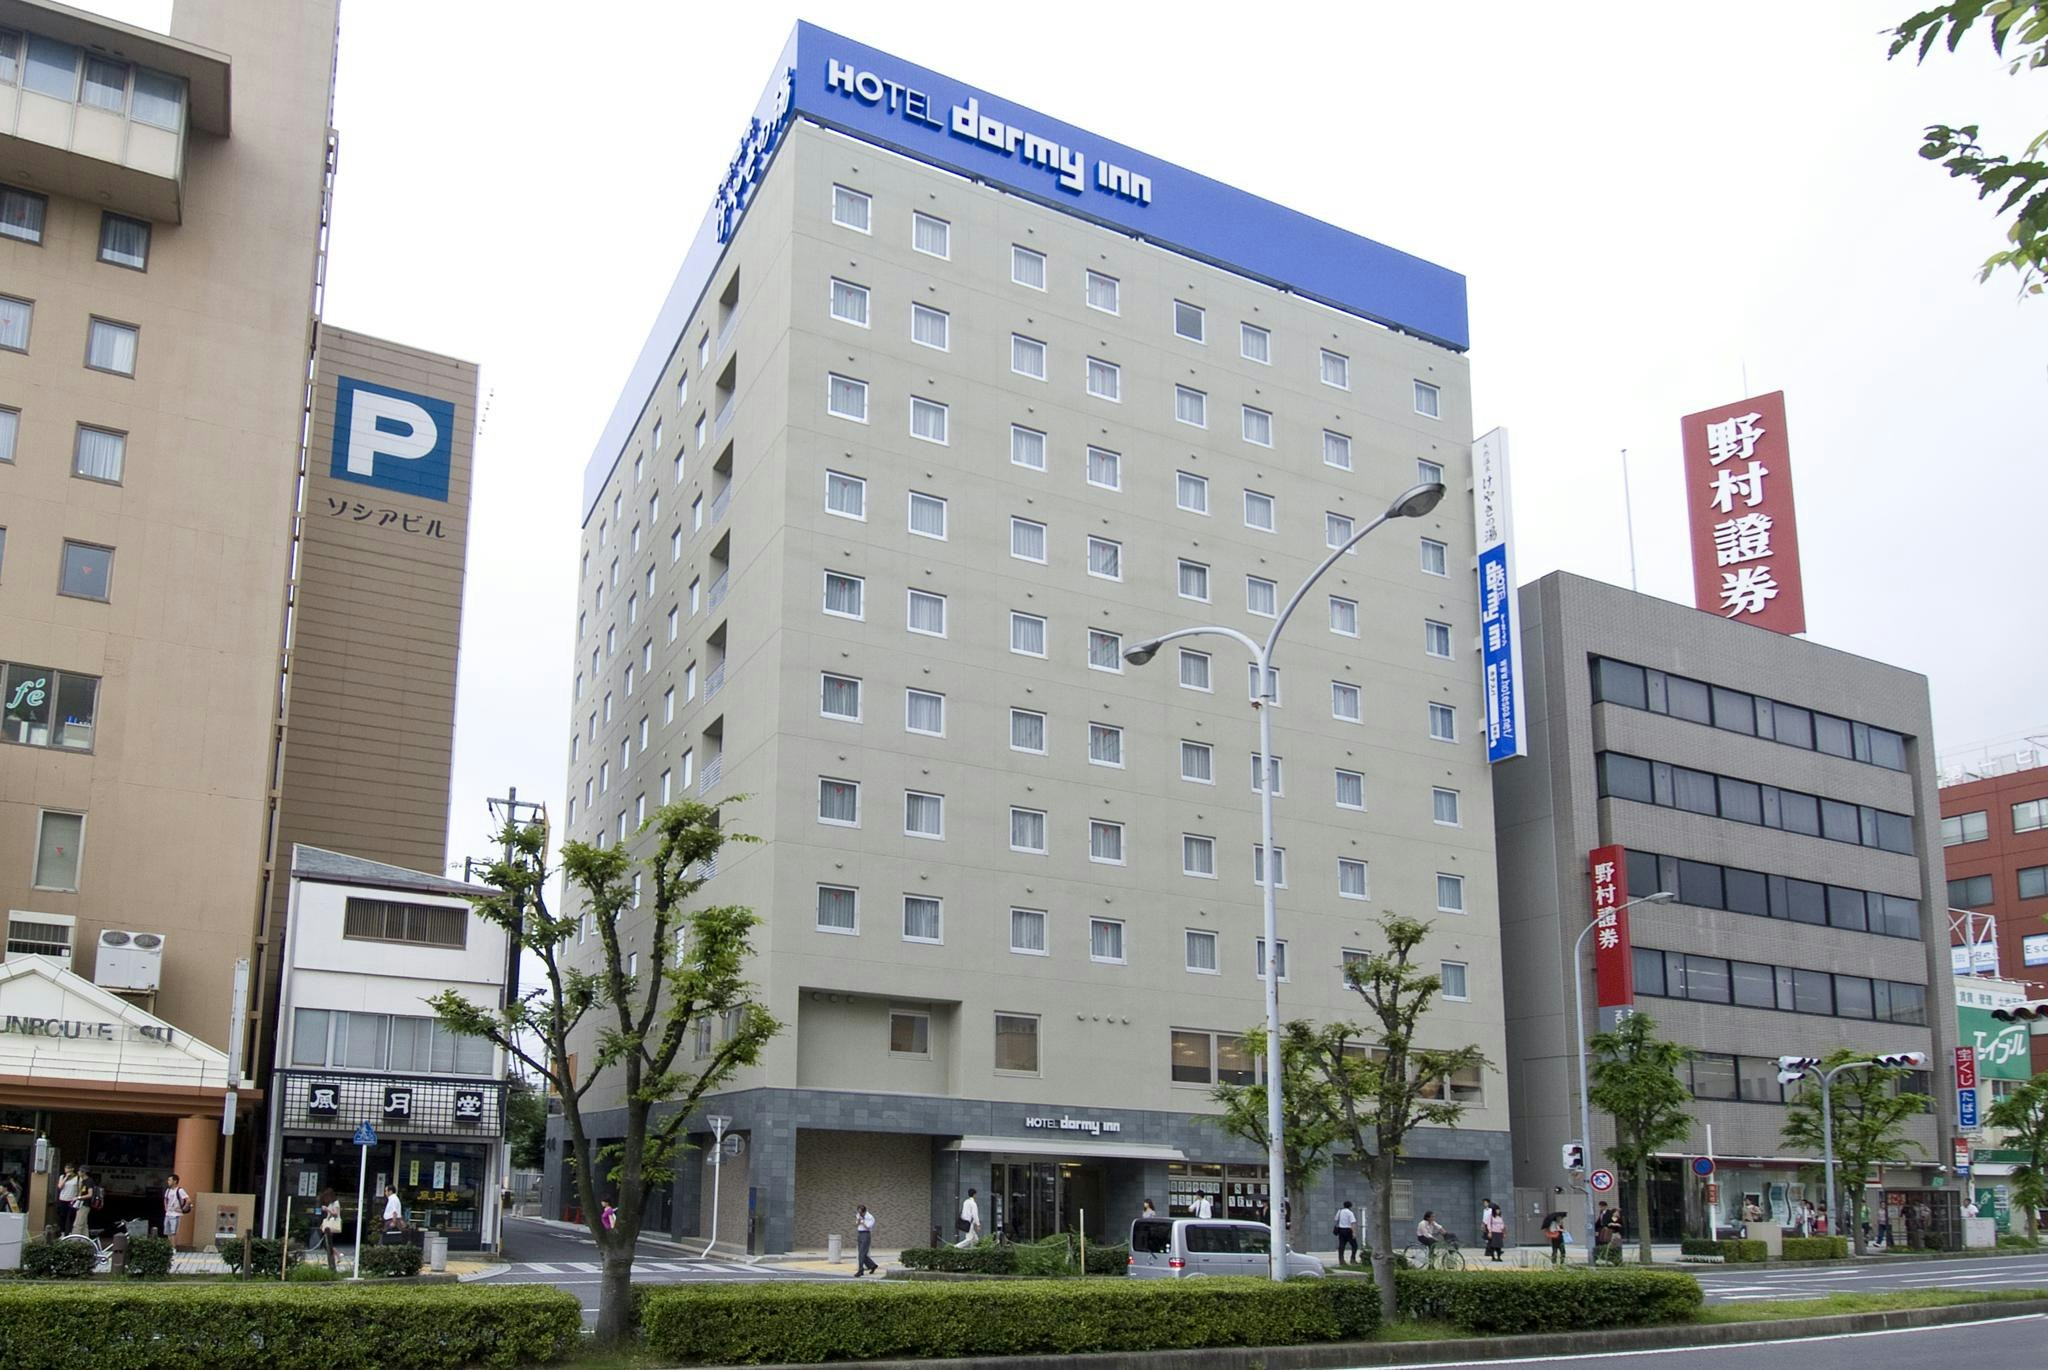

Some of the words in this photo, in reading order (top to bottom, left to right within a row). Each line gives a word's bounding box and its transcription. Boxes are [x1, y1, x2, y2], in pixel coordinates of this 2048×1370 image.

[828, 57, 944, 126] HOTEL
[951, 96, 1085, 191] dormy
[1098, 159, 1152, 203] inn
[346, 388, 438, 477] P
[327, 496, 446, 539] ソシアビル
[1705, 411, 1780, 619] 野村證券
[1483, 560, 1501, 624] dormy
[1594, 861, 1619, 950] 野村證券
[1973, 1025, 2026, 1064] エイブル
[1957, 1049, 1973, 1086] 宝くじ
[310, 1089, 481, 1117] 風月堂
[1026, 1117, 1059, 1129] HOTEL
[1060, 1114, 1100, 1135] dormy
[1103, 1121, 1120, 1132] inn
[1961, 1092, 1974, 1124] たばこ
